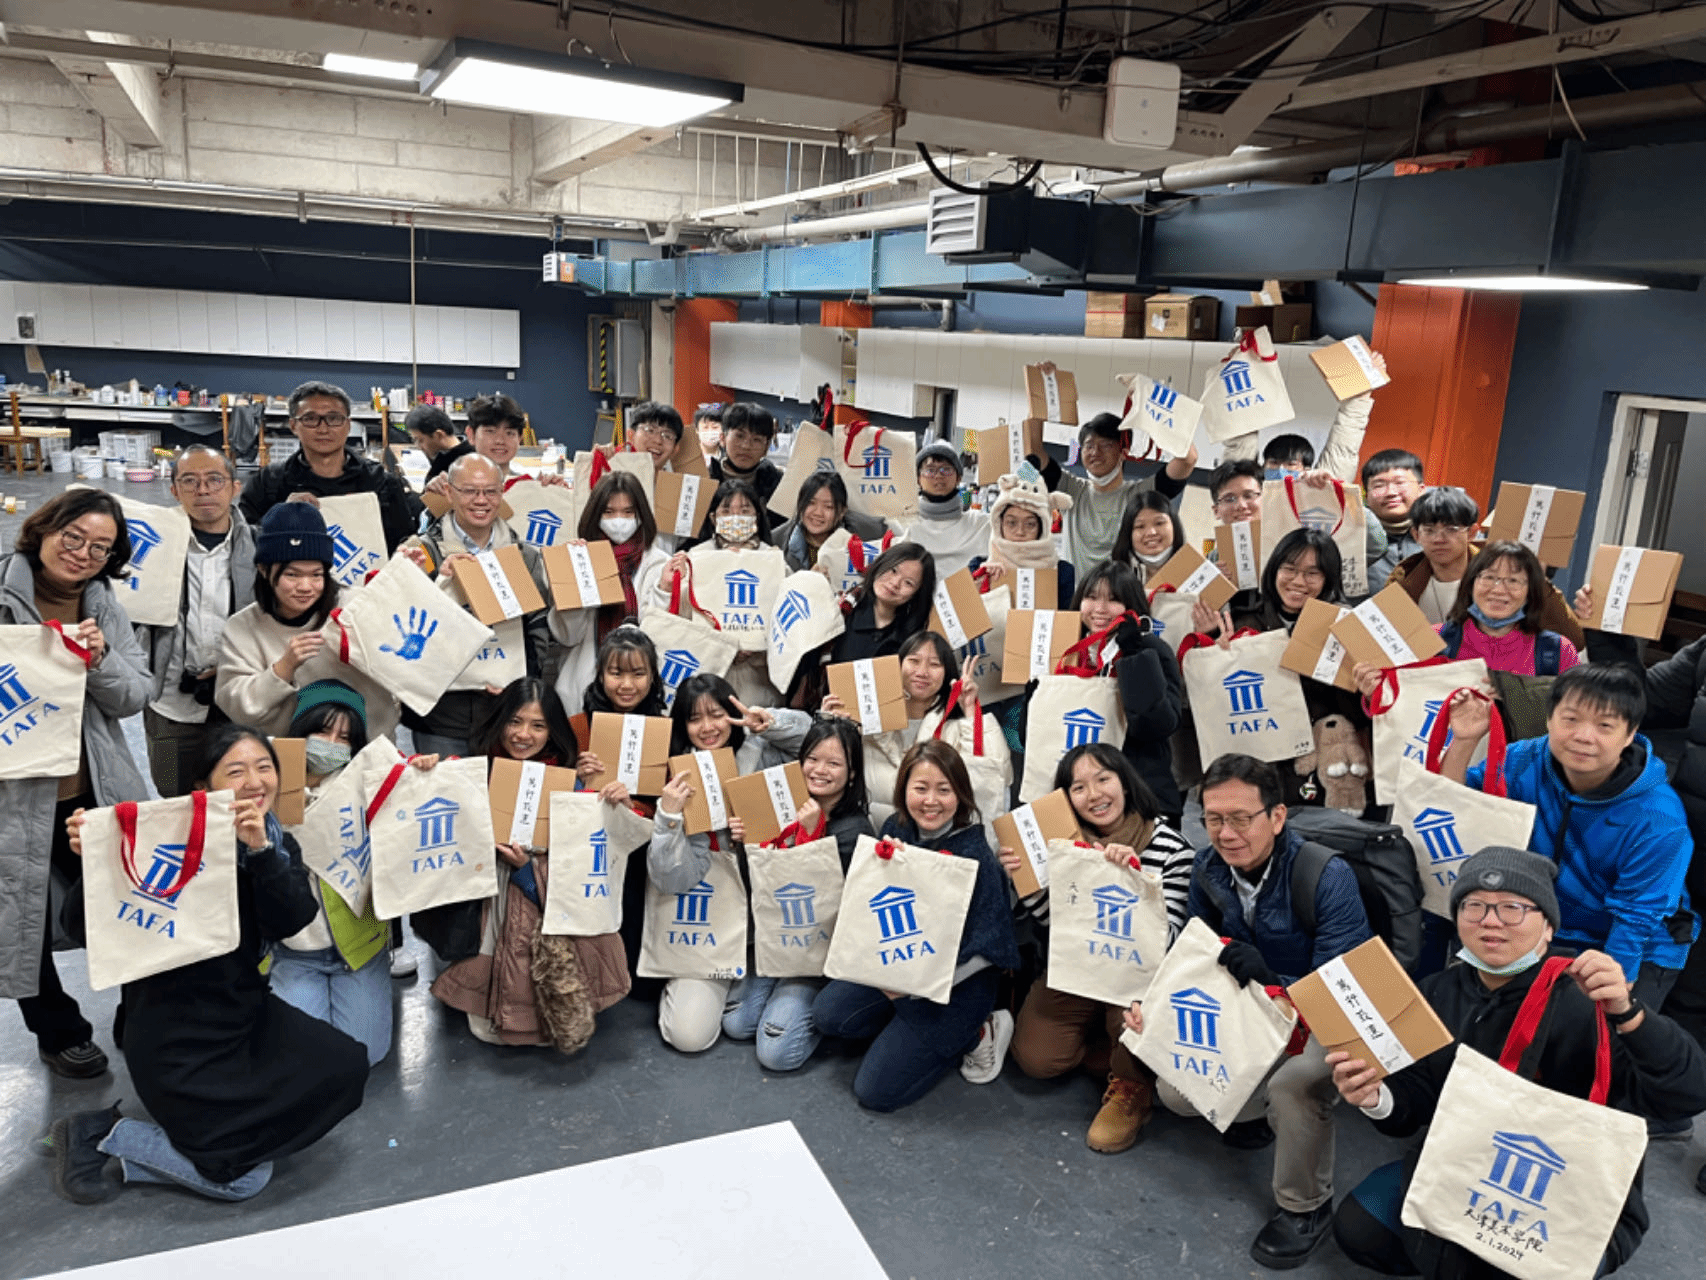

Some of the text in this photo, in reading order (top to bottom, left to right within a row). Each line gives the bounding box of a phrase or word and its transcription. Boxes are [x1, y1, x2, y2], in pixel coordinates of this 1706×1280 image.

[1224, 393, 1265, 412] TAFA
[860, 484, 896, 495] TAFA
[340, 550, 380, 585] TAFA
[720, 612, 765, 625] TAFA
[1, 701, 61, 748] TAFA
[1226, 717, 1279, 736] TAFA
[412, 851, 465, 874] TAFA
[114, 900, 176, 939] TAFA
[666, 930, 717, 947] TAFA
[779, 929, 829, 948] TAFA
[877, 940, 936, 966] TAFA
[1084, 939, 1143, 966] TAFA
[1169, 1051, 1231, 1084] TAFA
[1466, 1187, 1549, 1242] TAFA
